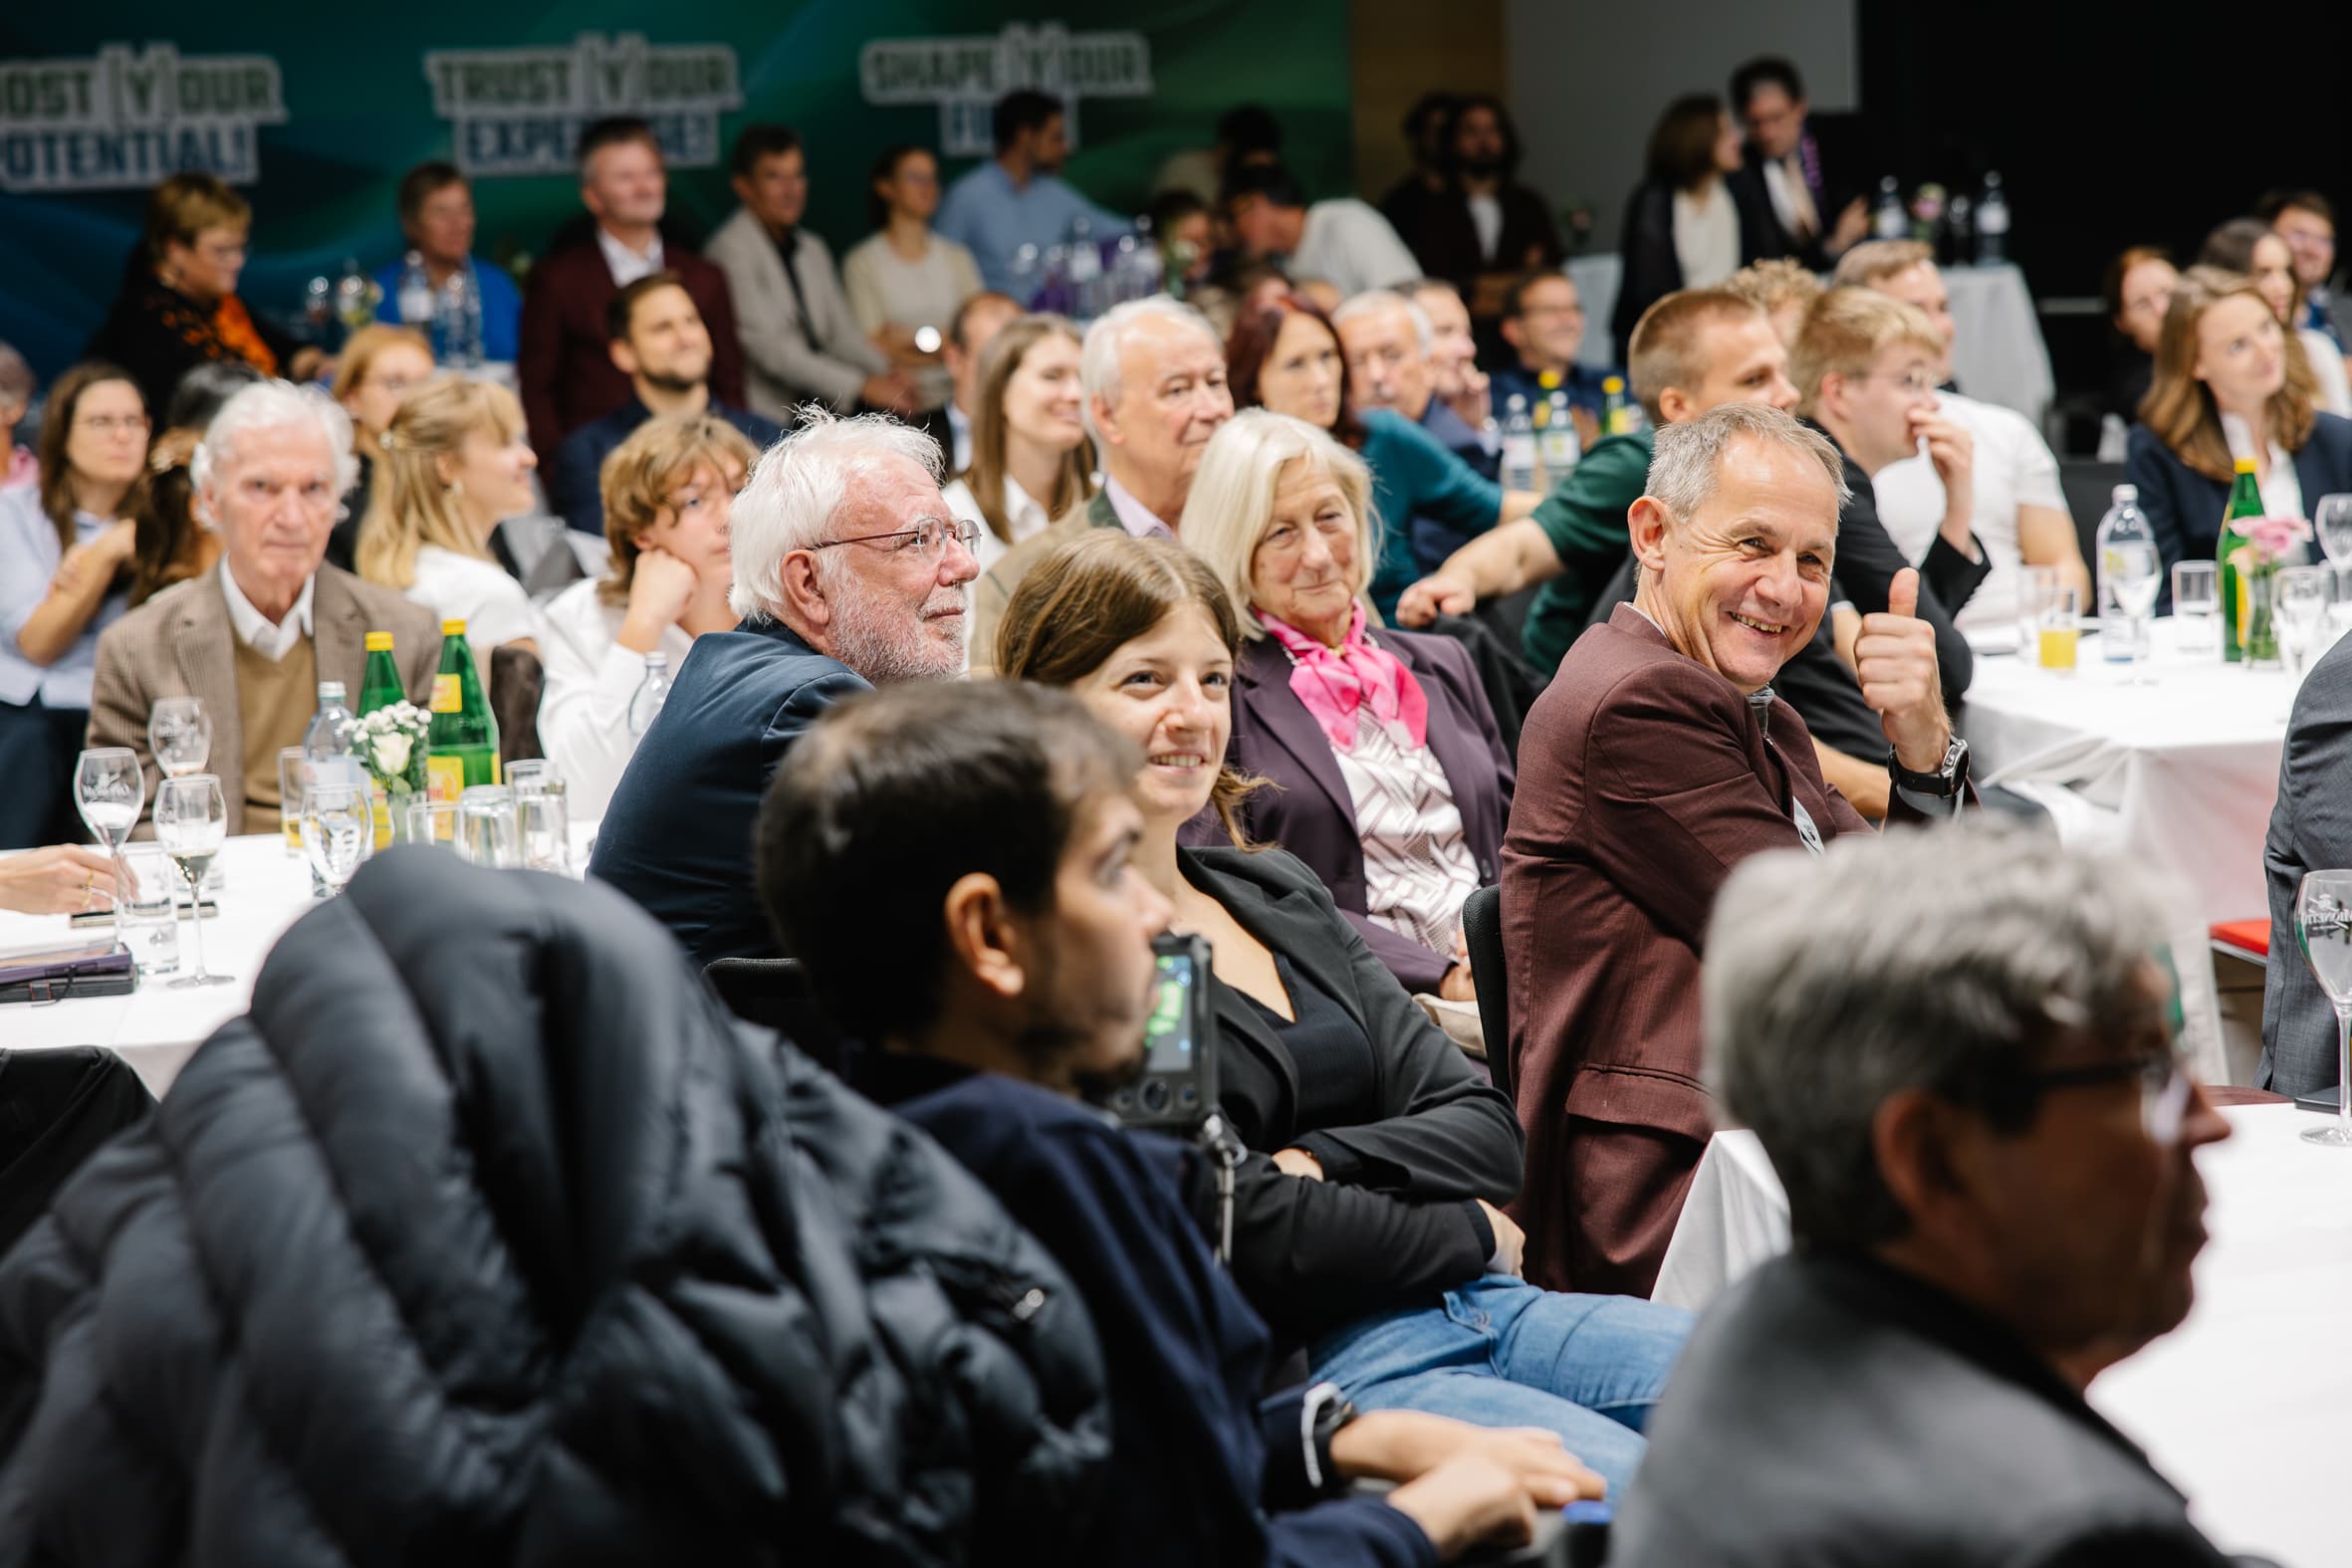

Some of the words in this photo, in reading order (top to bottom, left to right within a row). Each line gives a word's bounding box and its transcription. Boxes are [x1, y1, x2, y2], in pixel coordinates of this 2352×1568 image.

[0, 68, 94, 117] OST
[438, 59, 572, 105] TRUST
[873, 47, 995, 94] SHAPE
[0, 127, 248, 177] OTENTIAL!
